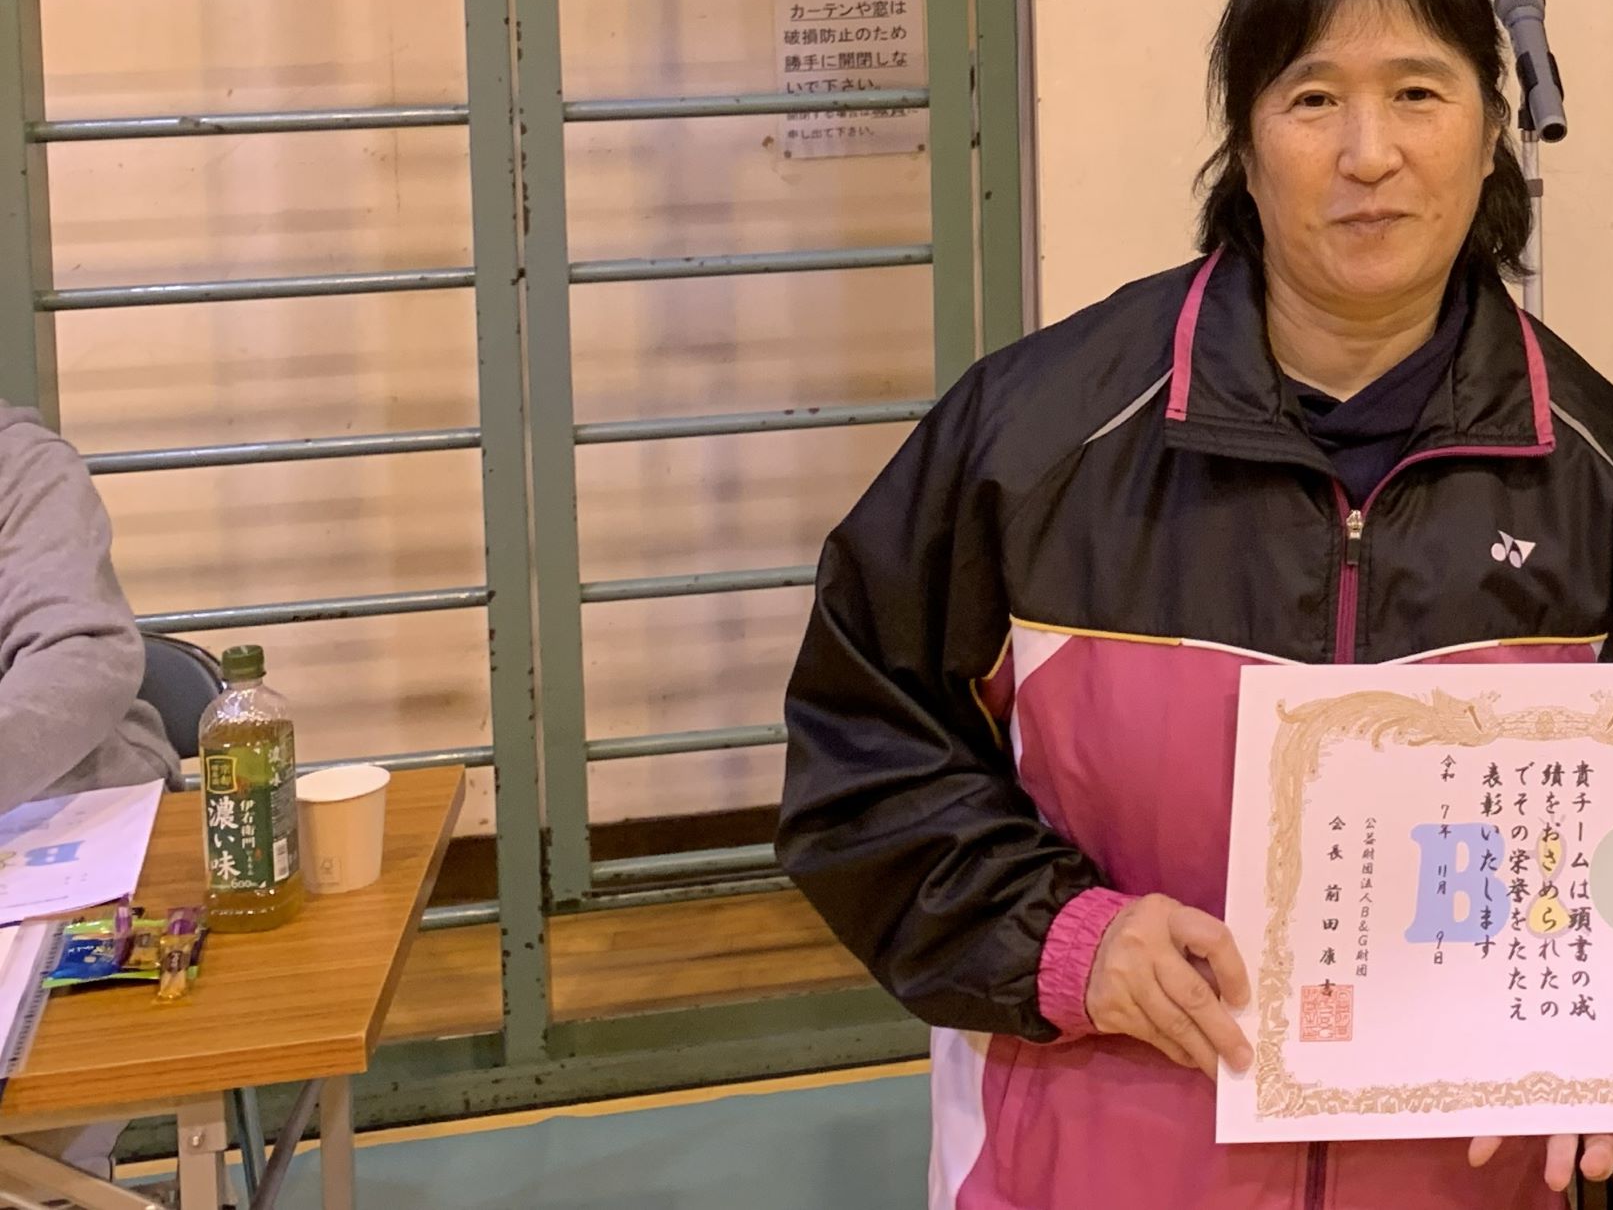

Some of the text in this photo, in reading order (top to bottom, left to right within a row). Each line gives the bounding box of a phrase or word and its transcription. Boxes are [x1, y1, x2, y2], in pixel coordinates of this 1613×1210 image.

[784, 26, 907, 45] 破損防止のため
[785, 50, 908, 71] 勝手に開閉しな
[790, 0, 907, 20] カーテンや窓は
[208, 795, 241, 880] 濃い味
[1475, 762, 1503, 959] 表彰いたします
[1506, 761, 1535, 1021] でその栄誉をたたえ
[1539, 763, 1565, 1018] 績をおさめられたの
[1568, 760, 1596, 1021] 貴チームは頭書の成
